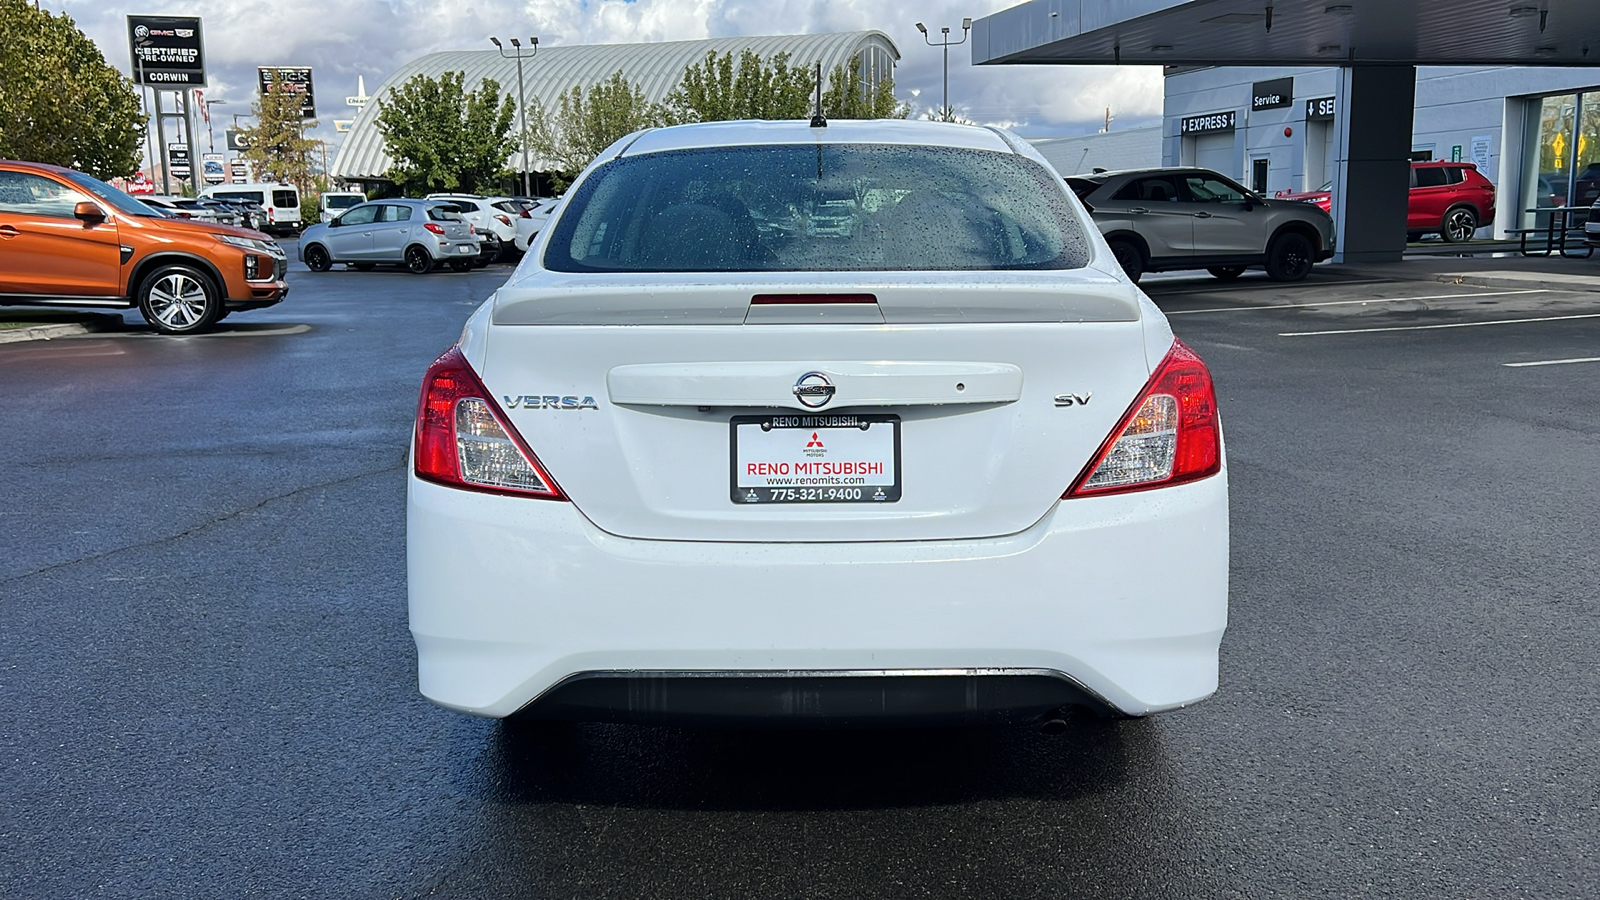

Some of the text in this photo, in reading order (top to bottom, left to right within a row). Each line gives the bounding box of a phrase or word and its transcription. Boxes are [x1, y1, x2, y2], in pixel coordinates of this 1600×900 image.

[135, 47, 198, 56] CERTIFIED
[149, 72, 189, 82] CORWIN
[1254, 93, 1280, 107] Service
[1188, 114, 1228, 132] EXPRESS
[234, 133, 258, 147] Co
[128, 182, 153, 193] Wendy's
[503, 395, 599, 410] VERSA
[1054, 391, 1093, 408] SV
[772, 416, 858, 427] RENO MITSUBISHI
[747, 462, 883, 475] RENO MITSUBISHI
[766, 475, 865, 486] www.renomits.com
[770, 488, 862, 501] 775-321-9400
